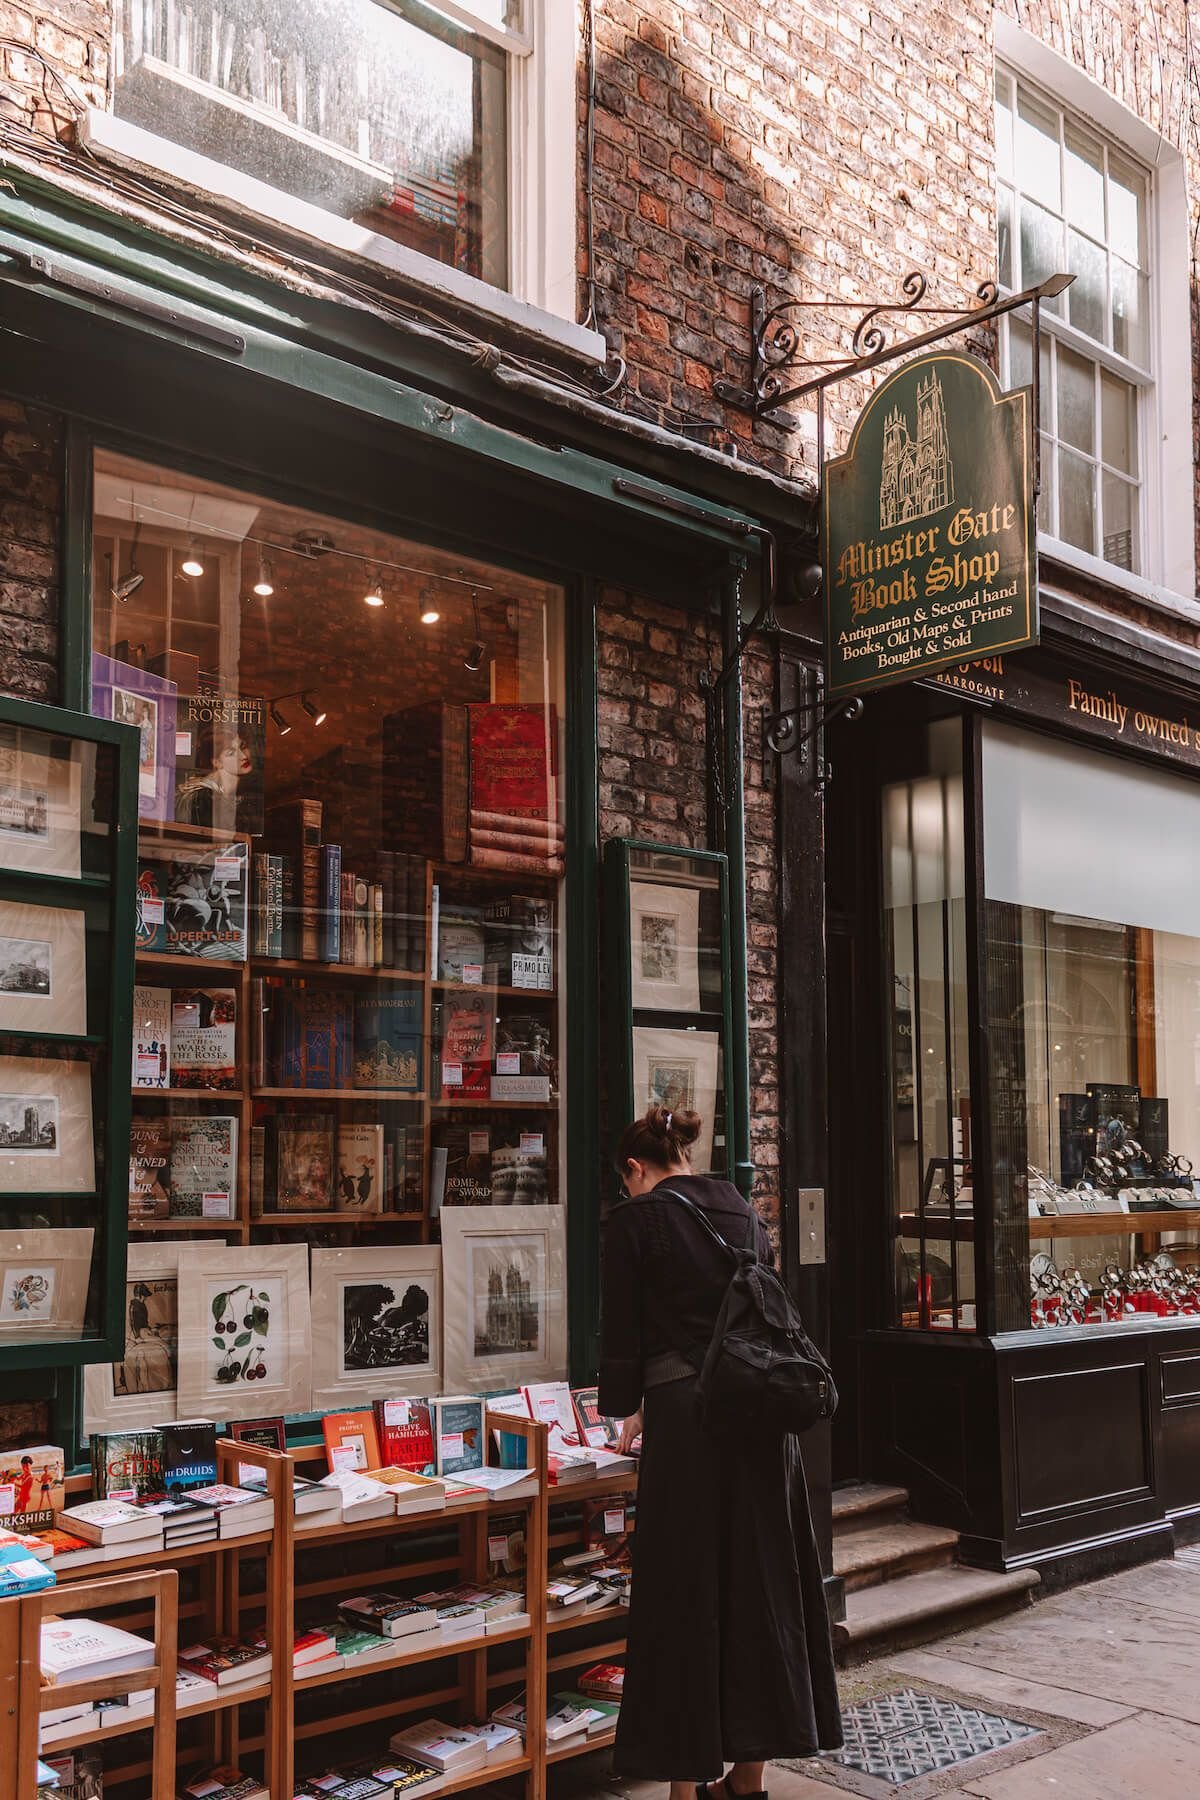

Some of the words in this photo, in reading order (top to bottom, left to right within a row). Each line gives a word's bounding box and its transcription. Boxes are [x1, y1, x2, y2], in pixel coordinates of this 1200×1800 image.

[835, 526, 940, 587] Minster
[947, 502, 1016, 547] Gate
[850, 568, 918, 623] Book
[924, 550, 1000, 597] Shop
[837, 615, 911, 645] Antiquarian
[913, 607, 929, 623] &
[931, 592, 979, 618] Second
[983, 580, 1018, 604] hand
[842, 640, 884, 661] Books,
[887, 628, 910, 648] Old
[912, 621, 949, 642] Maps
[951, 614, 968, 630] &
[971, 604, 1013, 625] Prints
[877, 647, 923, 669] Bought
[925, 639, 940, 655] &
[943, 630, 972, 650] Sold
[188, 698, 221, 708] DANTE
[223, 699, 262, 710] GABRIEL
[188, 707, 262, 724] ROSSETTI
[1067, 678, 1129, 734] Family
[1135, 711, 1190, 747] owned
[275, 890, 283, 930] AUDEN
[167, 931, 213, 942] UPERT
[217, 931, 241, 942] LEE
[177, 1044, 206, 1053] WARS
[209, 1044, 223, 1053] OF
[173, 1052, 191, 1060] THE
[195, 1052, 229, 1060] ROSES
[175, 1143, 218, 1155] SISTER
[447, 1178, 475, 1188] ROME
[459, 1186, 490, 1197] SWORD
[338, 1424, 364, 1432] PROPHET
[397, 1423, 420, 1432] CLIVE
[388, 1430, 430, 1441] HAMILTON
[107, 1458, 161, 1478] CELTS
[175, 1465, 214, 1478] DRUIDS
